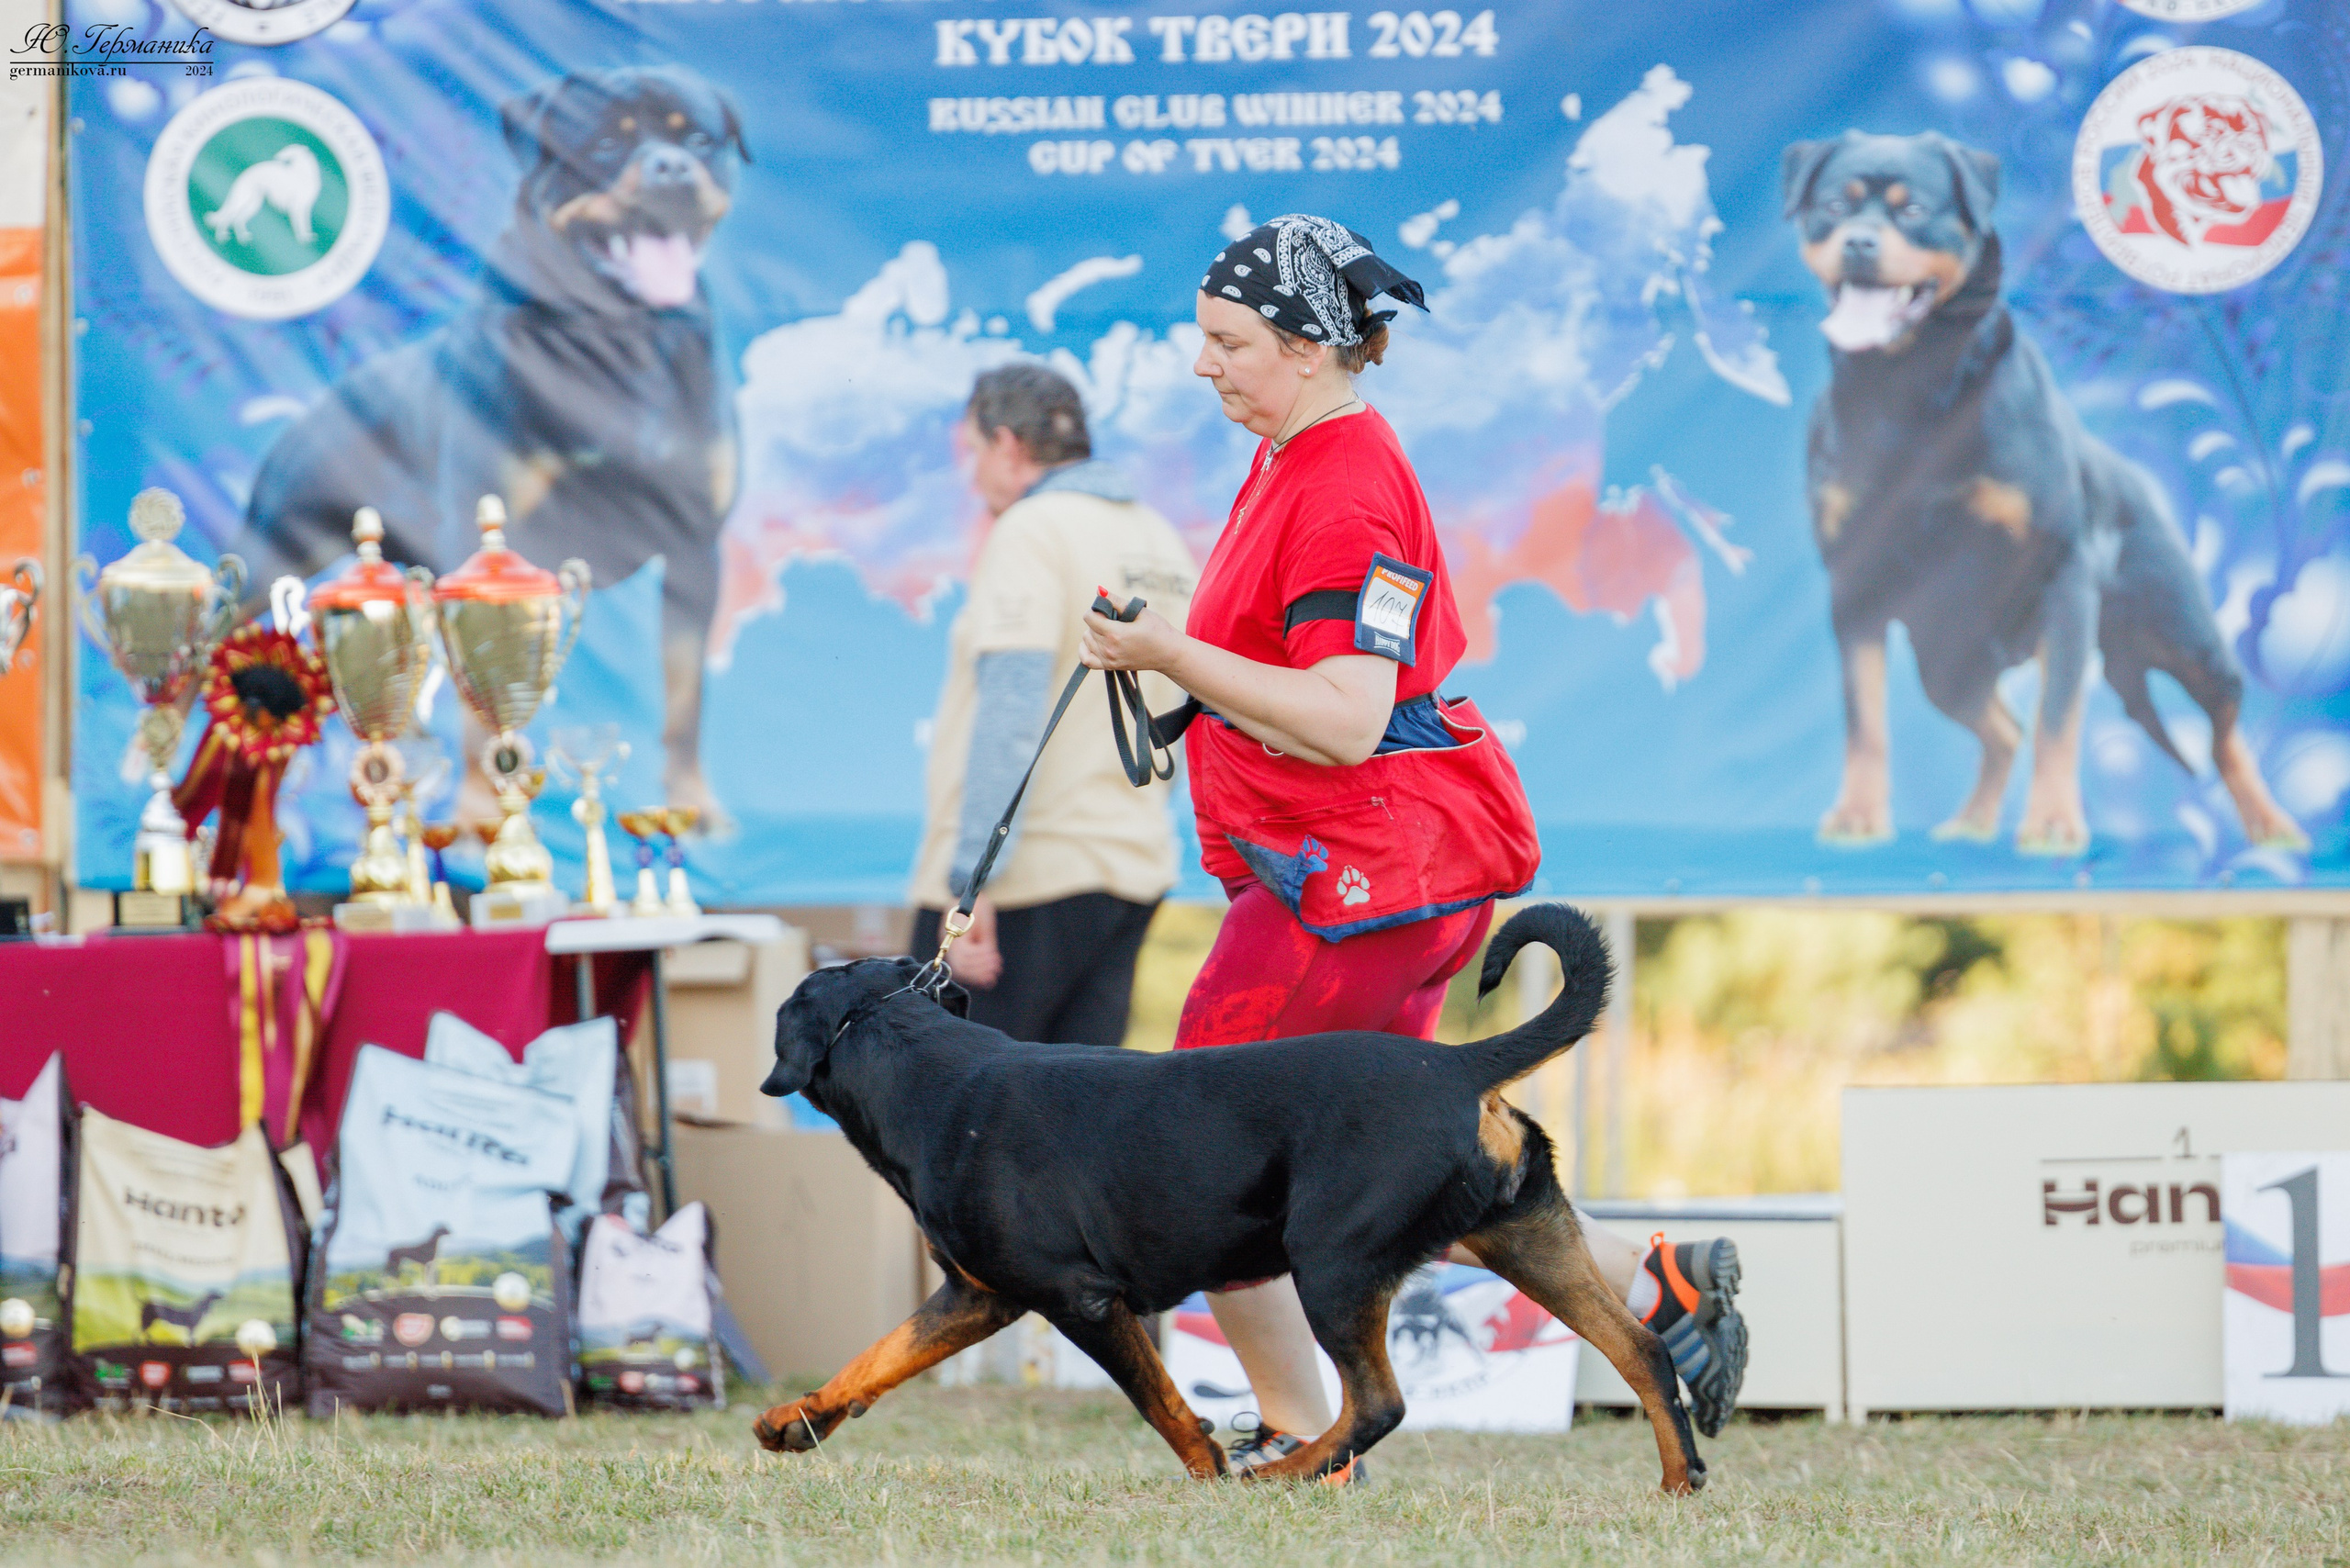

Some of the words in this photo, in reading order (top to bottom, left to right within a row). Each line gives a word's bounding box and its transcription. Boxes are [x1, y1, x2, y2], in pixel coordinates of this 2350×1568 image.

[935, 17, 1136, 67] КУБОК
[1367, 10, 1500, 60] 2024
[928, 96, 1106, 133] RUSSIAN
[1113, 94, 1226, 129] CLUB
[1232, 91, 1404, 126] WINNER
[1412, 90, 1504, 125] 2024
[1028, 140, 1116, 174] CUP
[1122, 139, 1180, 174] OF
[1185, 137, 1304, 173] TVER
[1310, 136, 1402, 172] 2024
[2256, 1163, 2350, 1379] 1
